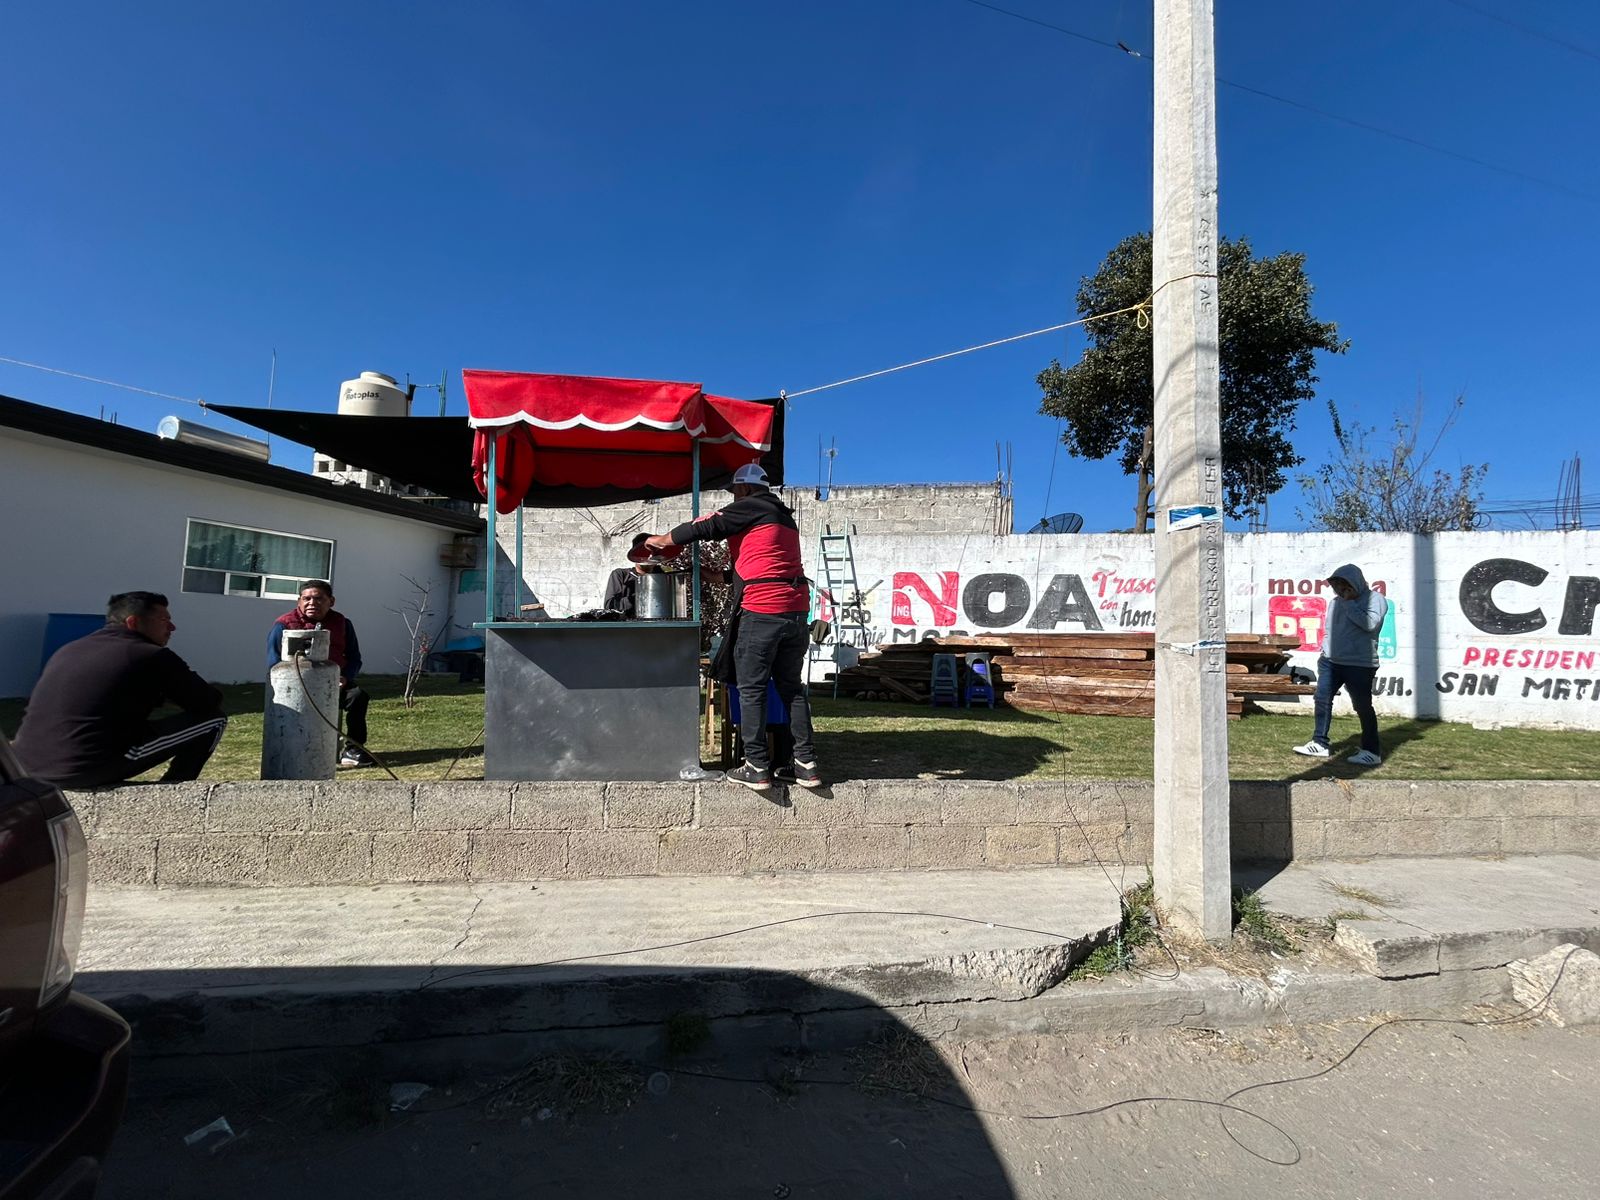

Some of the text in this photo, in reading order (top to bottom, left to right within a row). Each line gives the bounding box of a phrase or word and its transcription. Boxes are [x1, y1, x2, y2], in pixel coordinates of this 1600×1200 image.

[1092, 569, 1156, 597] Trasc
[1268, 579, 1386, 597] mora
[892, 571, 1105, 631] NOA
[893, 605, 910, 617] ING
[1275, 615, 1321, 645] PT
[1463, 646, 1600, 669] PRESIDEN
[1435, 672, 1499, 696] SAN
